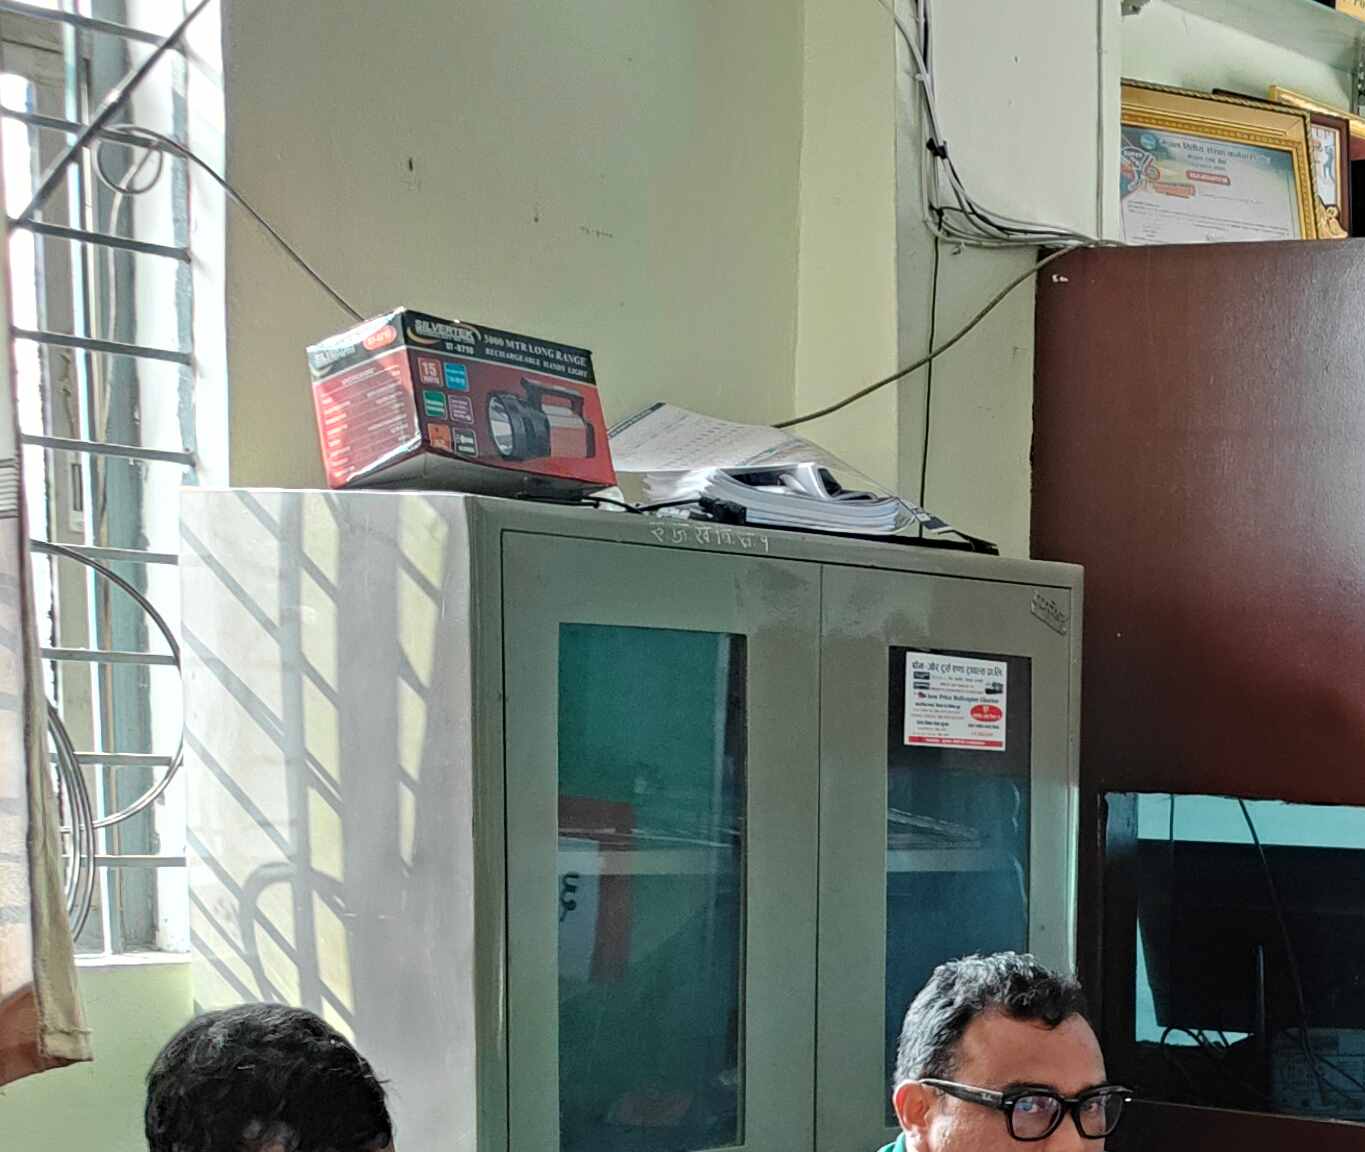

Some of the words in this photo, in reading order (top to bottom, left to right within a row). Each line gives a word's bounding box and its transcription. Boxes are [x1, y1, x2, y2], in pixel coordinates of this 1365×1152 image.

[528, 344, 555, 359] LONG
[556, 350, 587, 367] RANGE
[421, 361, 438, 377] 15
